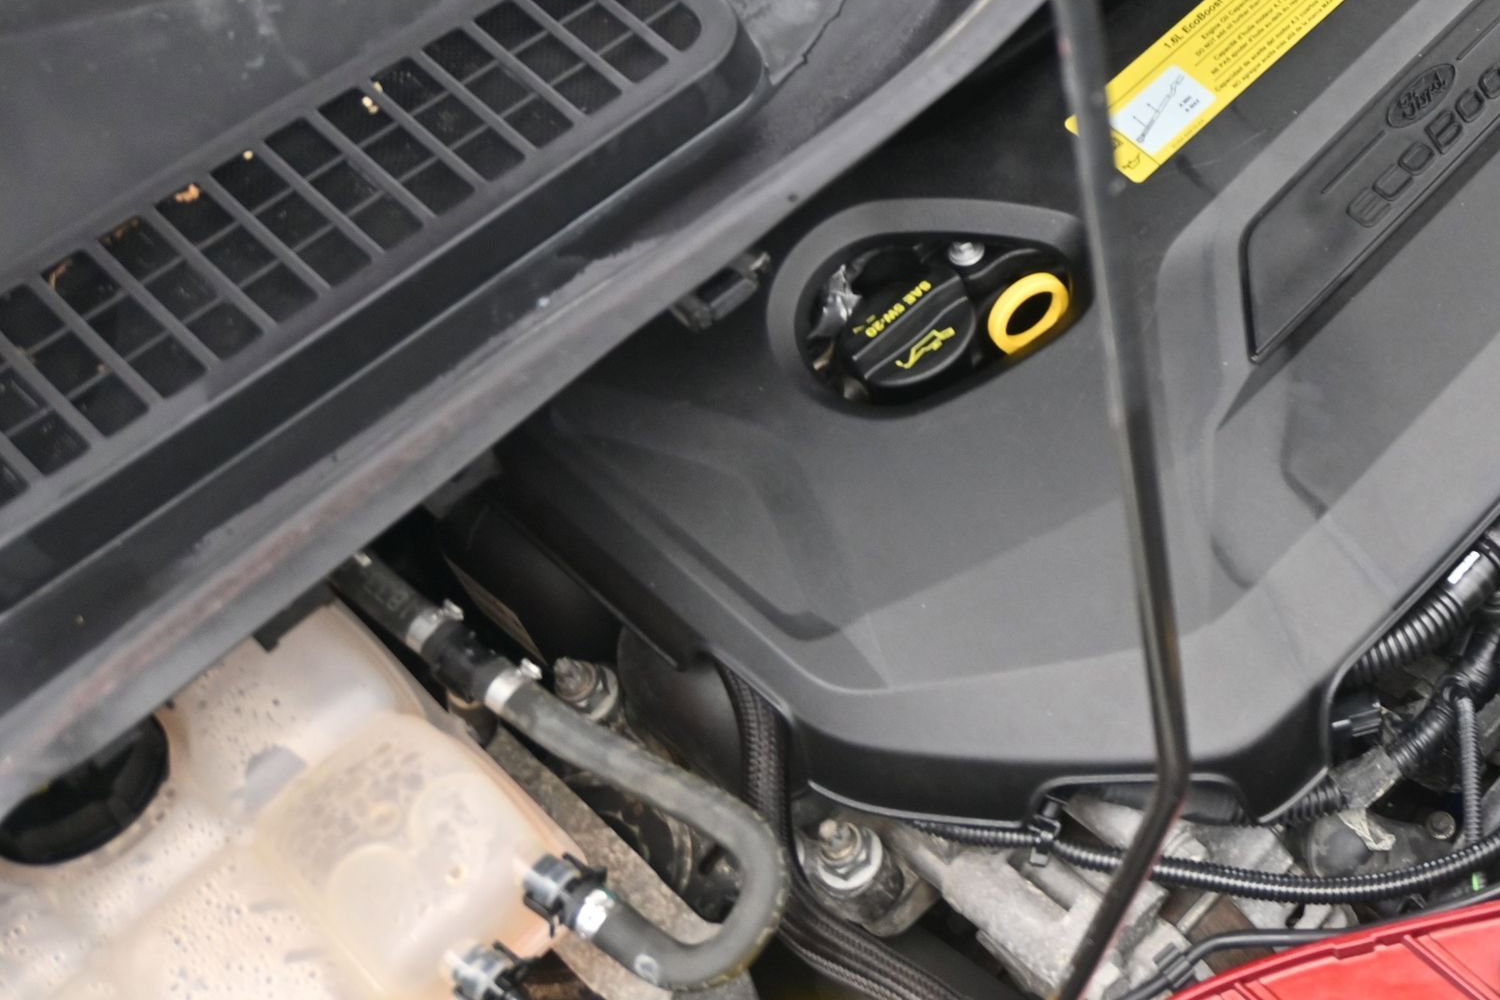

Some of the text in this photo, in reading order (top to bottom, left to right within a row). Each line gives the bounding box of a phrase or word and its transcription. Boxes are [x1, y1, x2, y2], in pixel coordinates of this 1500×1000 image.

[1195, 48, 1204, 56] DO
[1204, 38, 1214, 48] NOT
[1216, 29, 1225, 38] add
[1231, 9, 1248, 23] further
[1249, 0, 1260, 9] than
[1201, 23, 1220, 39] Engine
[1219, 14, 1228, 22] Oil
[1255, 8, 1272, 24] moteur
[1164, 34, 1183, 48] 1.6L
[1214, 66, 1243, 91] Capacidad
[1251, 46, 1266, 60] aceite
[1266, 37, 1274, 45] del
[1275, 24, 1290, 38] motor
[1299, 0, 1318, 16] cuartos
[1218, 57, 1230, 67] PAS
[1231, 42, 1247, 57] ajouter
[1241, 63, 1260, 80] agregue
[1261, 49, 1275, 62] aceite
[1307, 8, 1322, 21] marca
[1397, 71, 1447, 120] Ford
[902, 280, 931, 305] SAE
[864, 302, 905, 337] 5W-20
